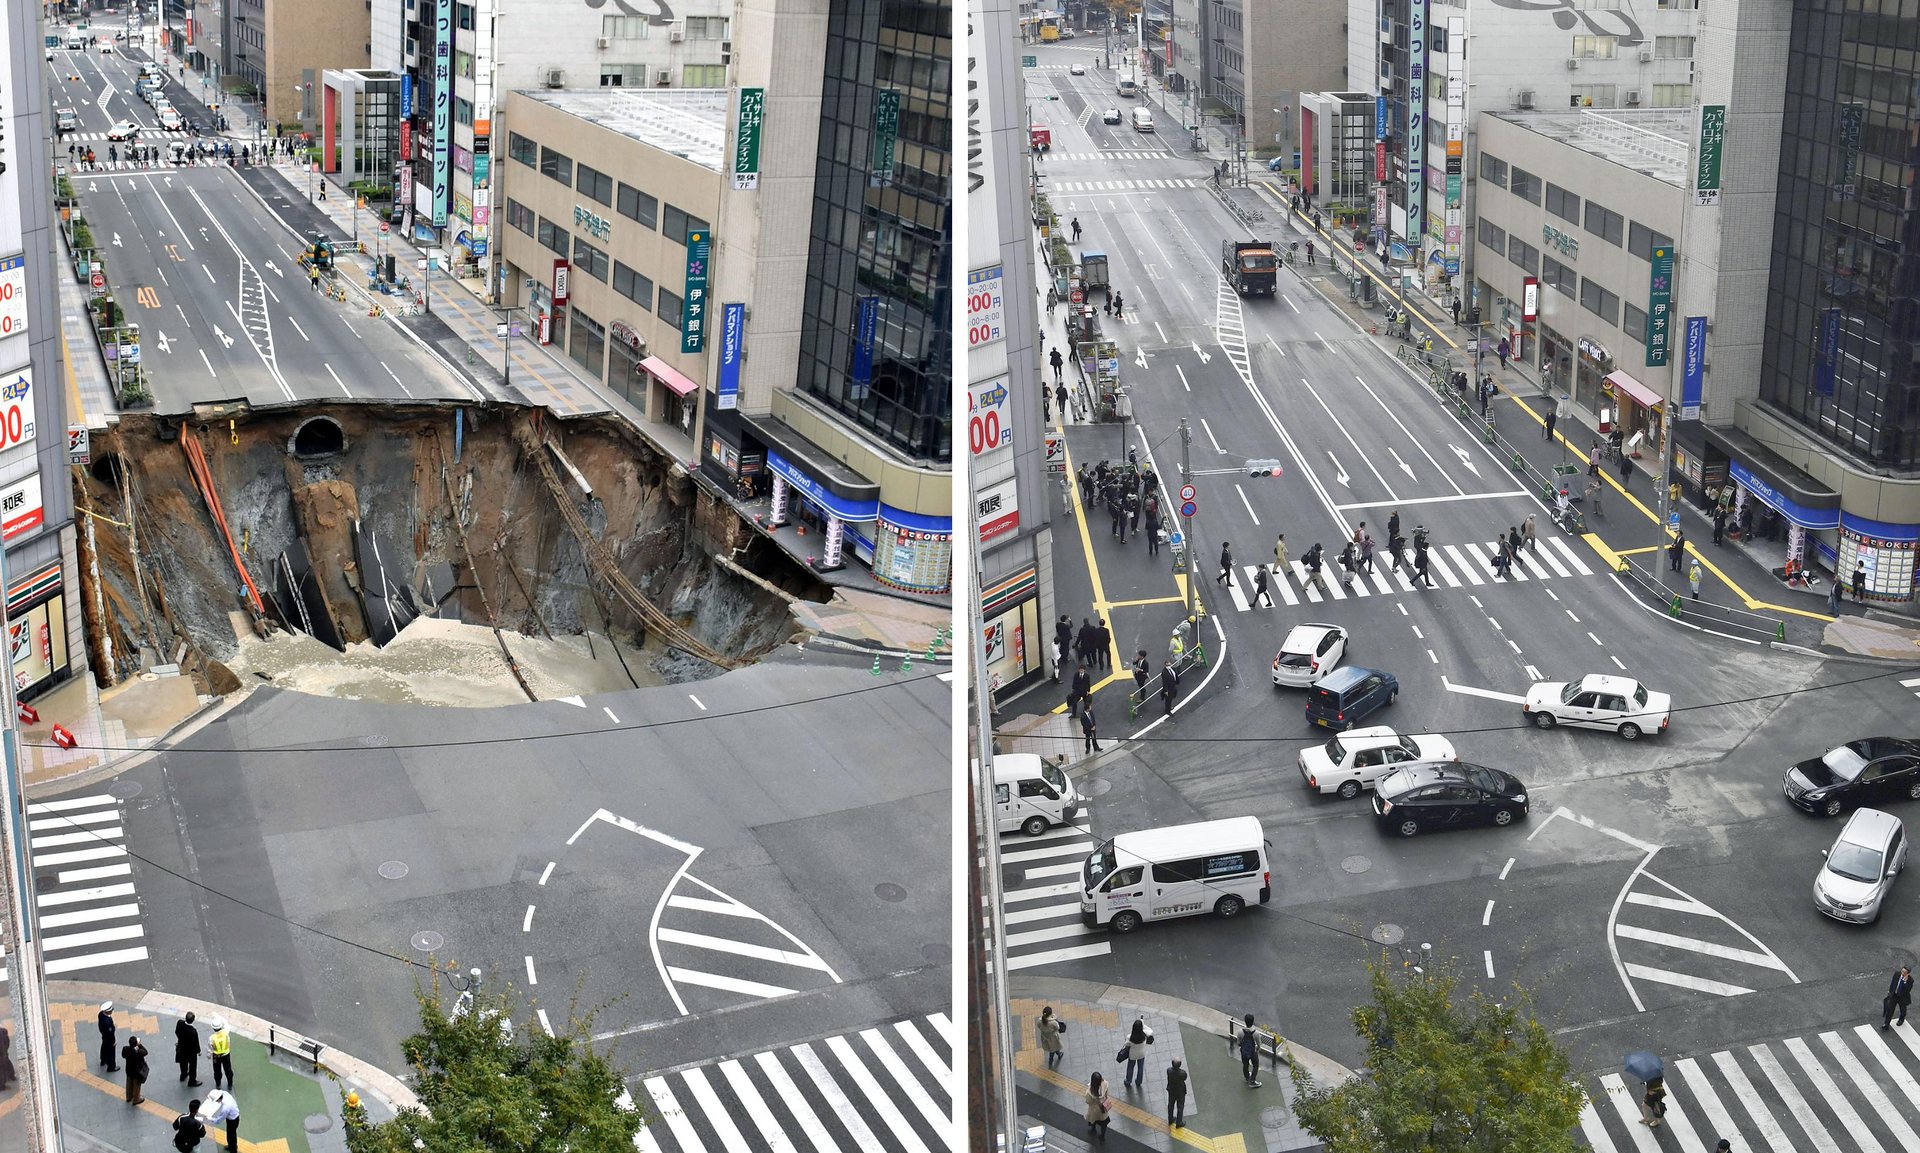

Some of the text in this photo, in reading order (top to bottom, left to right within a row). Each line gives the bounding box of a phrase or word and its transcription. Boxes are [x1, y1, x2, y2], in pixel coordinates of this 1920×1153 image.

[754, 92, 763, 127] マサキ
[1409, 0, 1423, 220] らつ歯科クリニック
[1715, 109, 1724, 143] マサキ
[737, 96, 754, 172] カイロプラクティック
[1700, 113, 1716, 188] カイロプラクティック
[737, 174, 755, 182] 整体
[1699, 190, 1718, 198] 整体
[574, 203, 611, 244] 伊予銀行
[0, 283, 23, 301] 0円
[137, 286, 161, 309] 40
[687, 288, 703, 347] 伊予銀行
[1652, 303, 1666, 361] 伊予銀行
[725, 307, 737, 365] アパマンショップ
[1688, 320, 1699, 377] アパマンショップ
[3, 386, 16, 401] 24
[981, 393, 994, 408] 24
[3, 491, 24, 511] 和民
[979, 495, 1001, 516] 和民
[1183, 488, 1193, 497] 40
